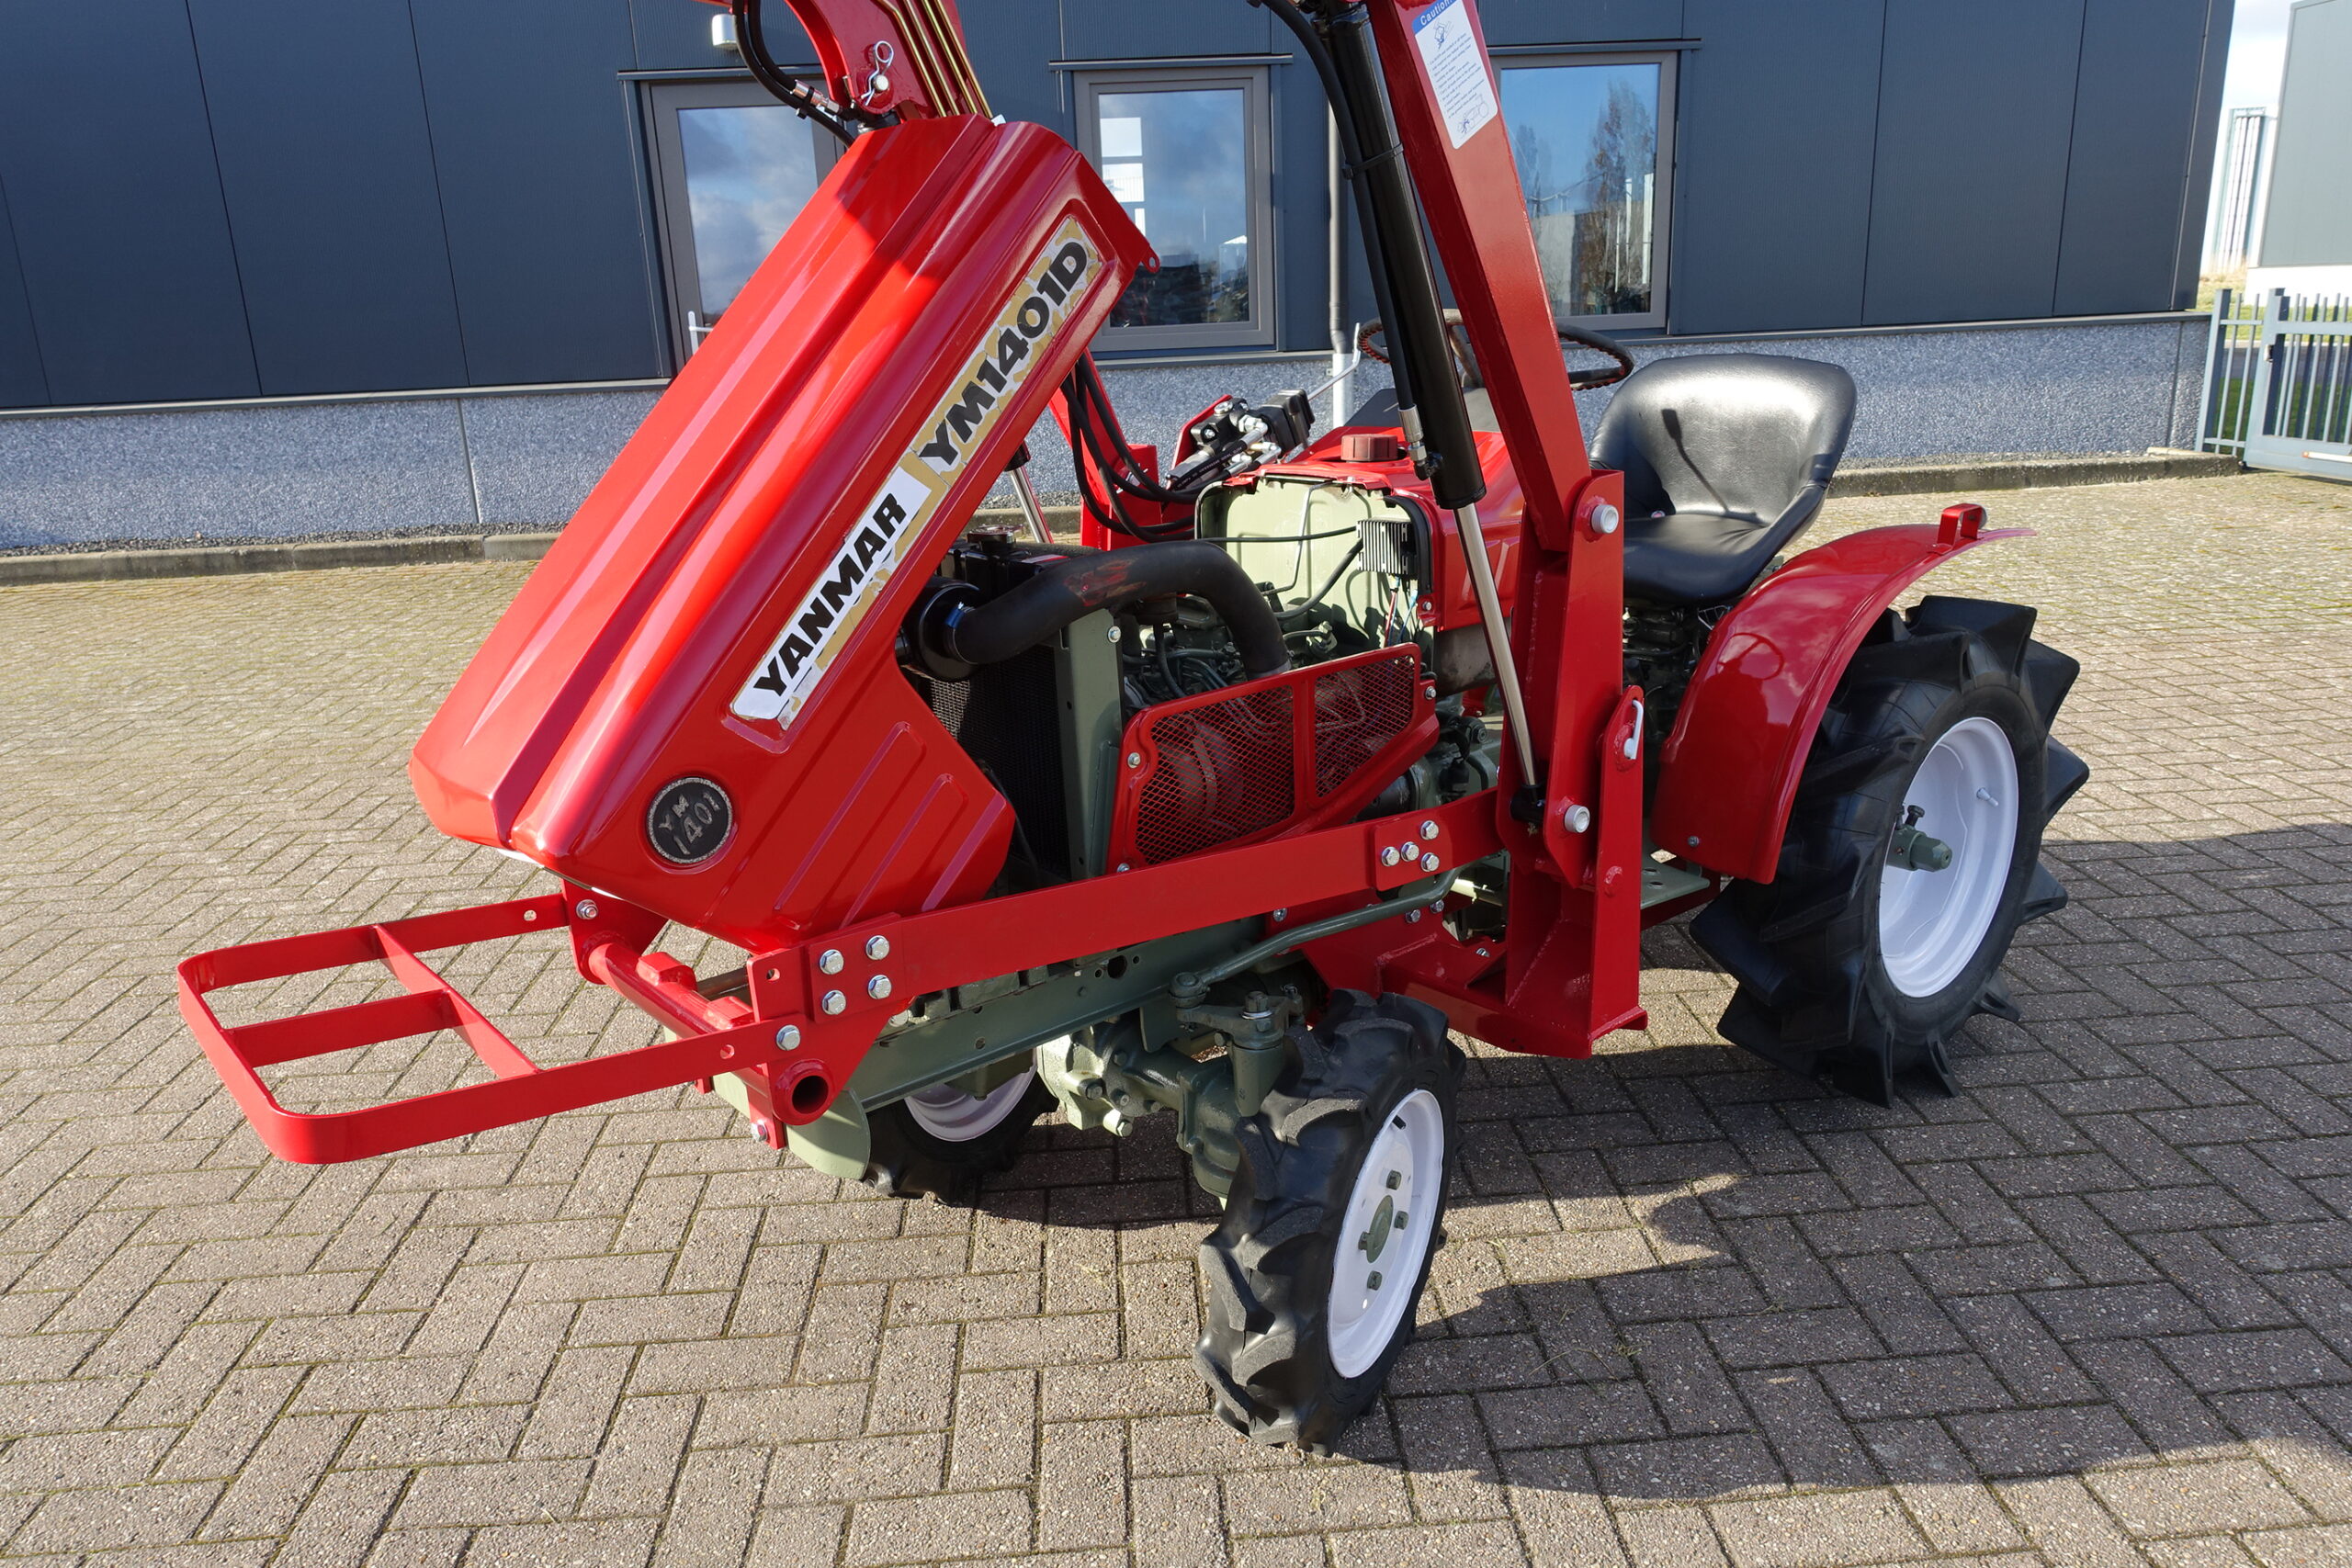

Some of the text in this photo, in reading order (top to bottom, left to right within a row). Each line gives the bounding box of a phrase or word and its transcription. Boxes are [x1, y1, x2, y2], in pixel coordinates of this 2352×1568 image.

[753, 241, 1088, 696] YANMAR YM1401D
[658, 795, 690, 831] YM
[673, 792, 721, 855] 1401
